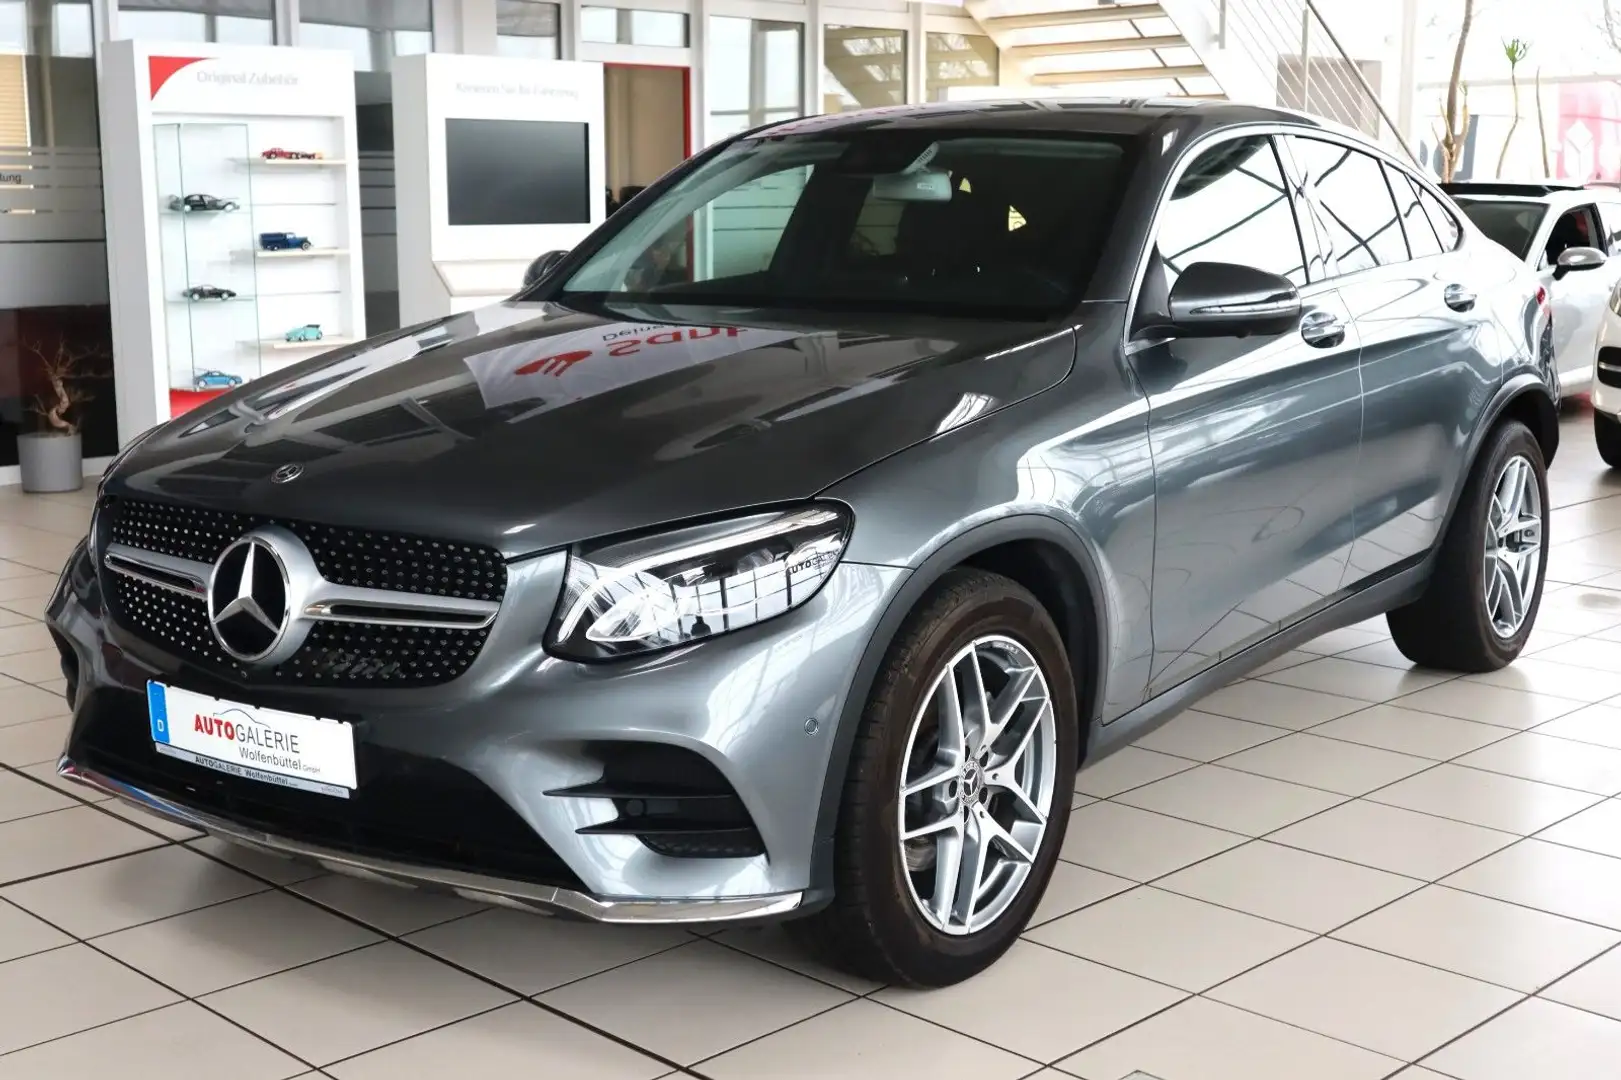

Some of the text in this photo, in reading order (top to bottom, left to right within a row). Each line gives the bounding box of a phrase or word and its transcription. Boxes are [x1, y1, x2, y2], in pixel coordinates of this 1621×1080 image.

[196, 70, 246, 86] Original
[157, 719, 165, 732] D
[194, 714, 300, 754] AUTOGALERIE
[238, 746, 302, 770] Wolfenbüttel
[195, 756, 289, 785] AUTOGALERIE Wolfenbüttel
